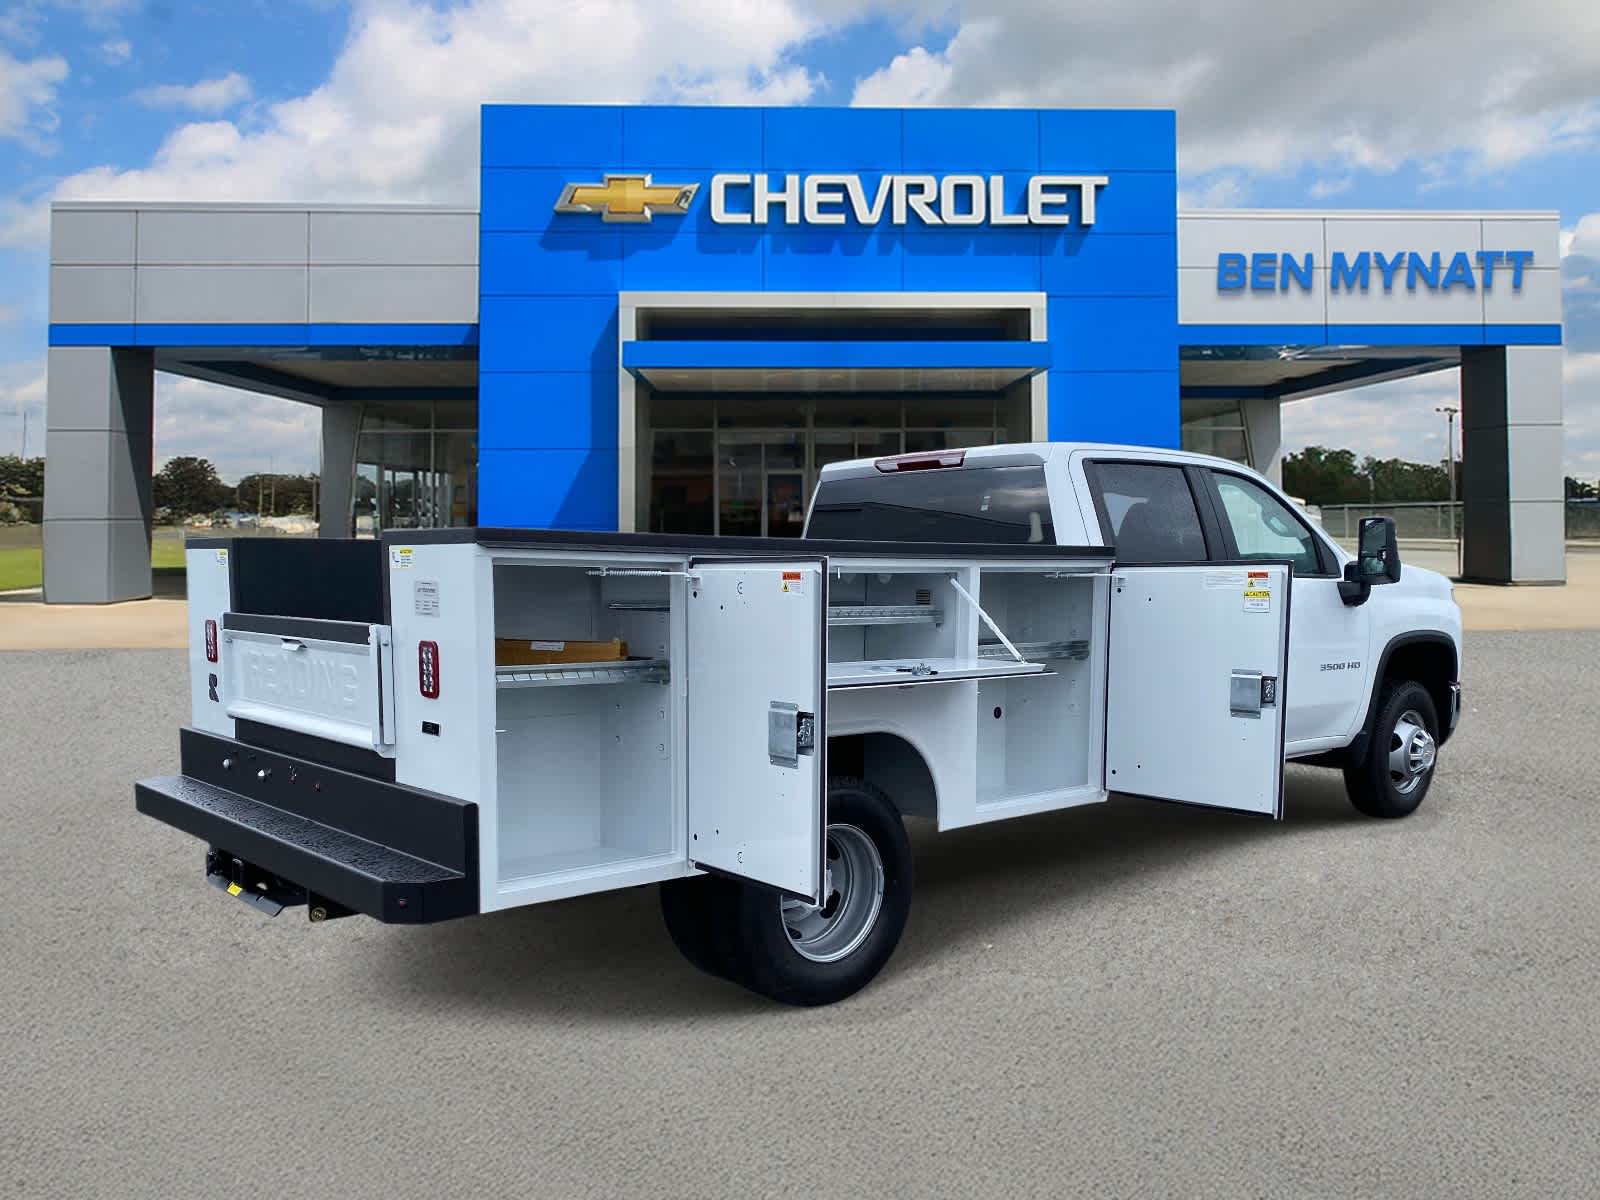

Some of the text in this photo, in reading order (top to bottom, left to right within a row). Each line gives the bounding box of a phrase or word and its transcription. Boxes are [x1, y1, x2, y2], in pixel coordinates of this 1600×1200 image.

[710, 173, 1109, 226] CHEVROLET
[1217, 250, 1534, 291] BEN MYNATT
[1320, 661, 1360, 672] 3500 HD
